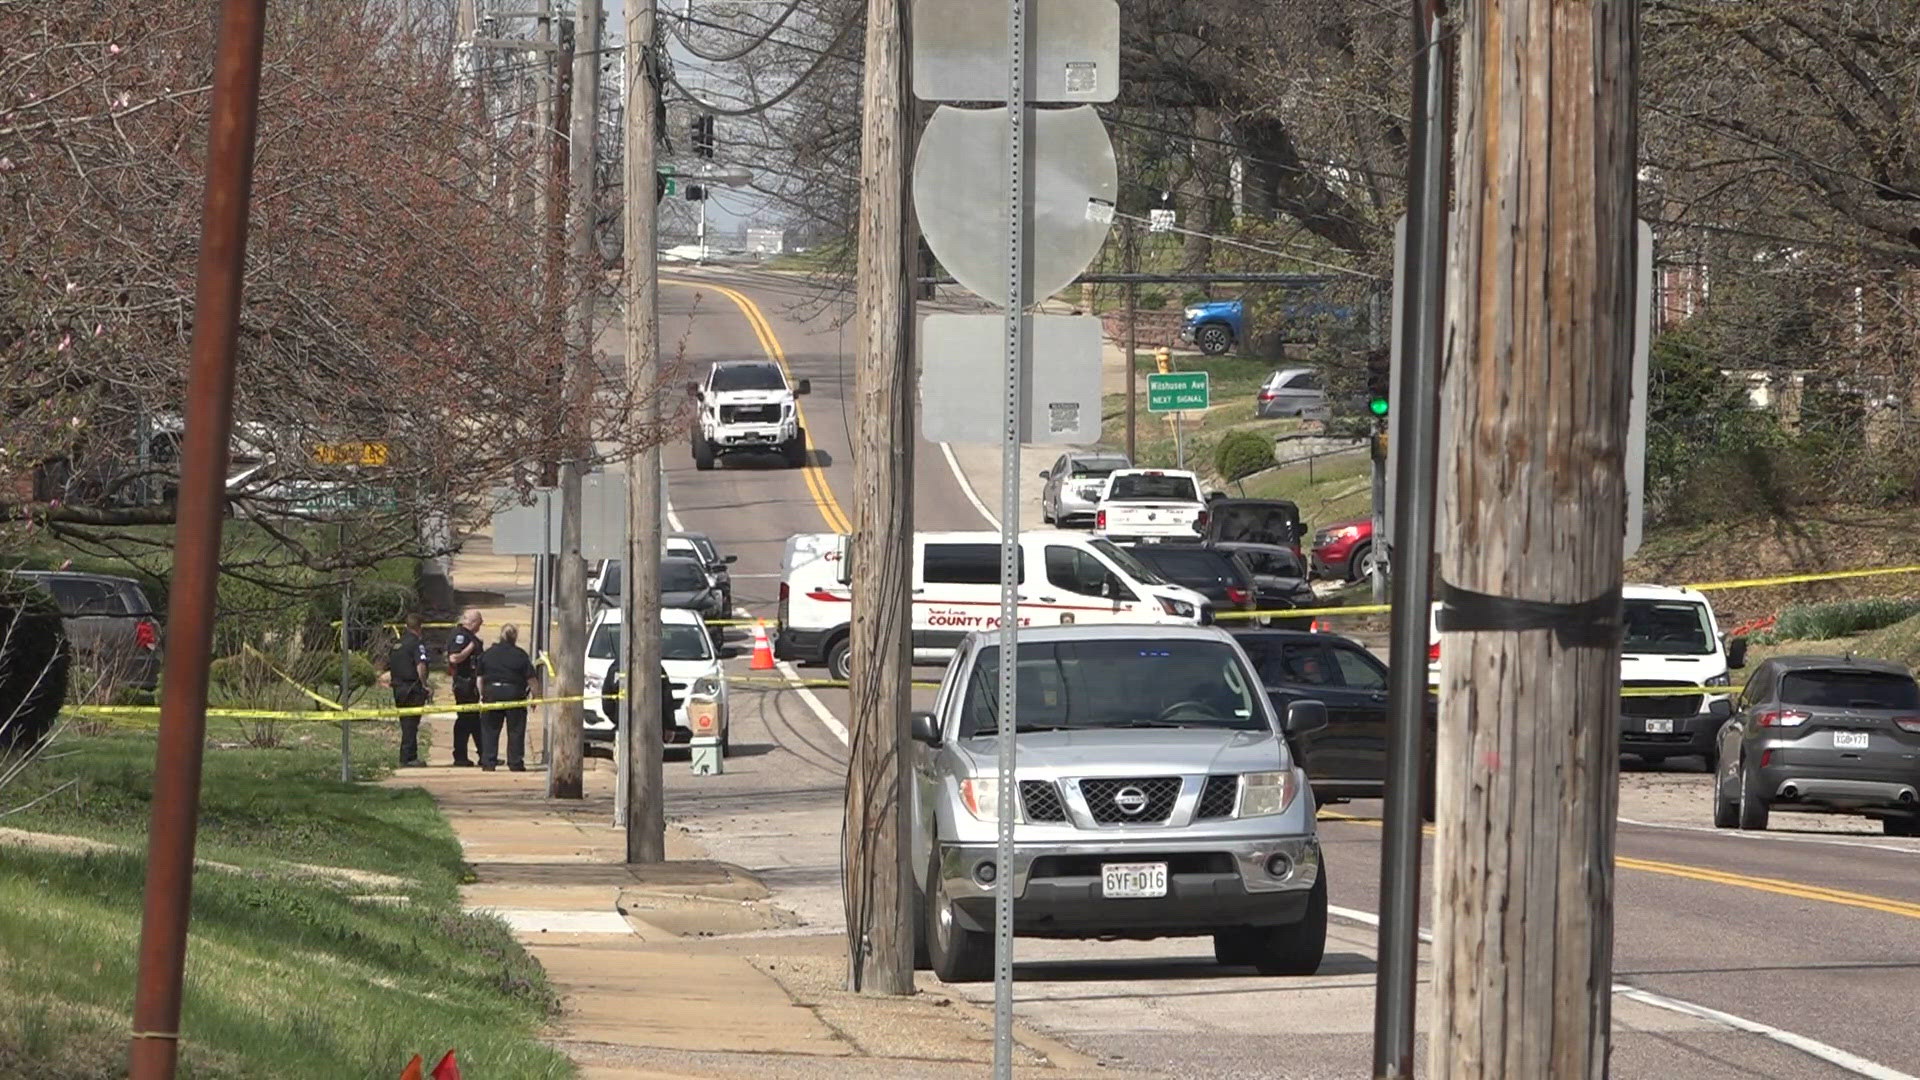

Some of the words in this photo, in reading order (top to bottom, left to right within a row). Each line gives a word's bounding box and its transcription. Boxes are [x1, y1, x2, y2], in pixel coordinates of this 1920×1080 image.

[1191, 381, 1205, 389] Ave
[1152, 396, 1171, 404] NEXT
[1177, 395, 1203, 403] SIGNAL
[928, 616, 982, 626] COUNTY
[1107, 873, 1131, 890] 6YF
